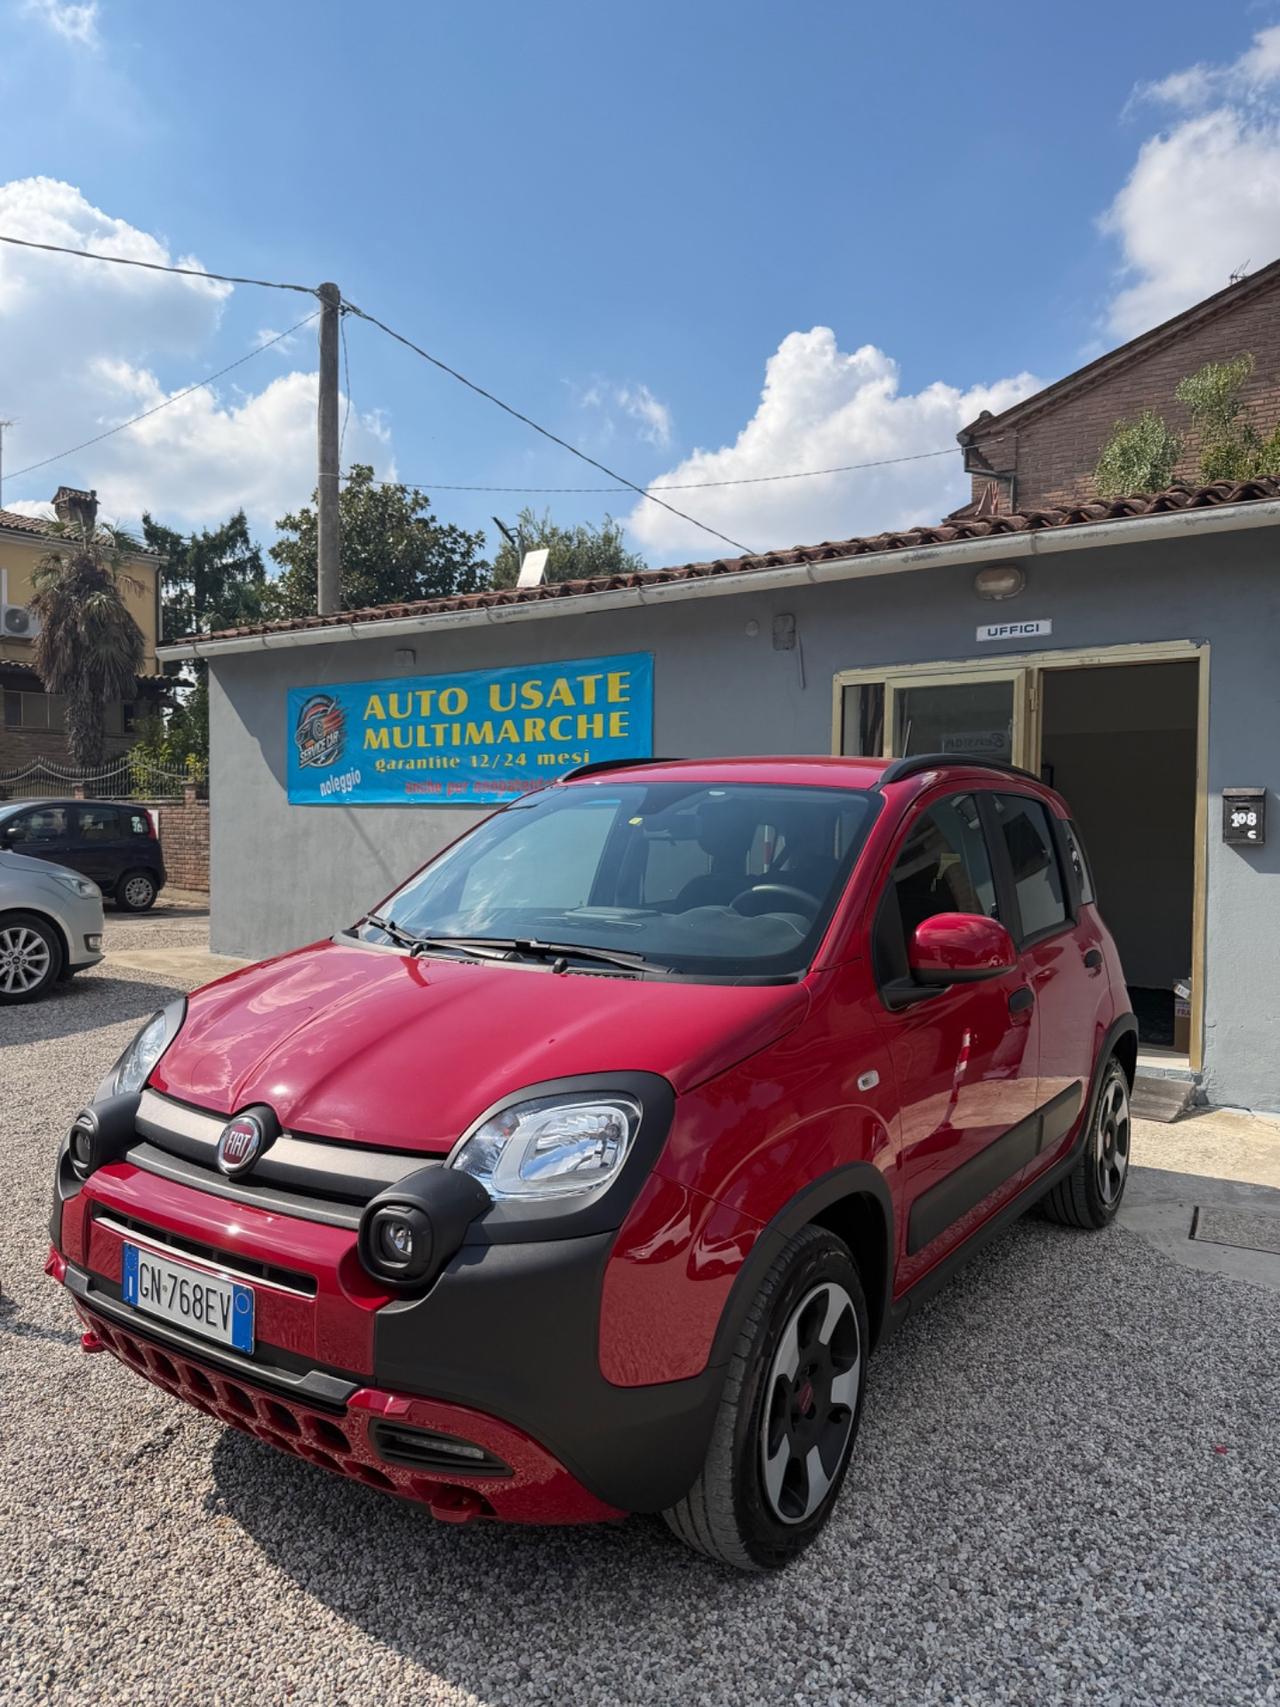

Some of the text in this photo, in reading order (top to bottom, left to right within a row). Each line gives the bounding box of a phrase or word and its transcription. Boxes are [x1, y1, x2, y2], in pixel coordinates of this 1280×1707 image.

[987, 623, 1039, 637] UFFICI
[363, 671, 631, 720] AUTO USATE
[363, 711, 629, 749] MULTIMARCHE
[375, 749, 590, 773] garantite 12/24 mesi
[319, 767, 361, 797] noleggio
[447, 781, 467, 796] per
[1231, 812, 1257, 827] 108
[225, 1131, 251, 1155] FIAT
